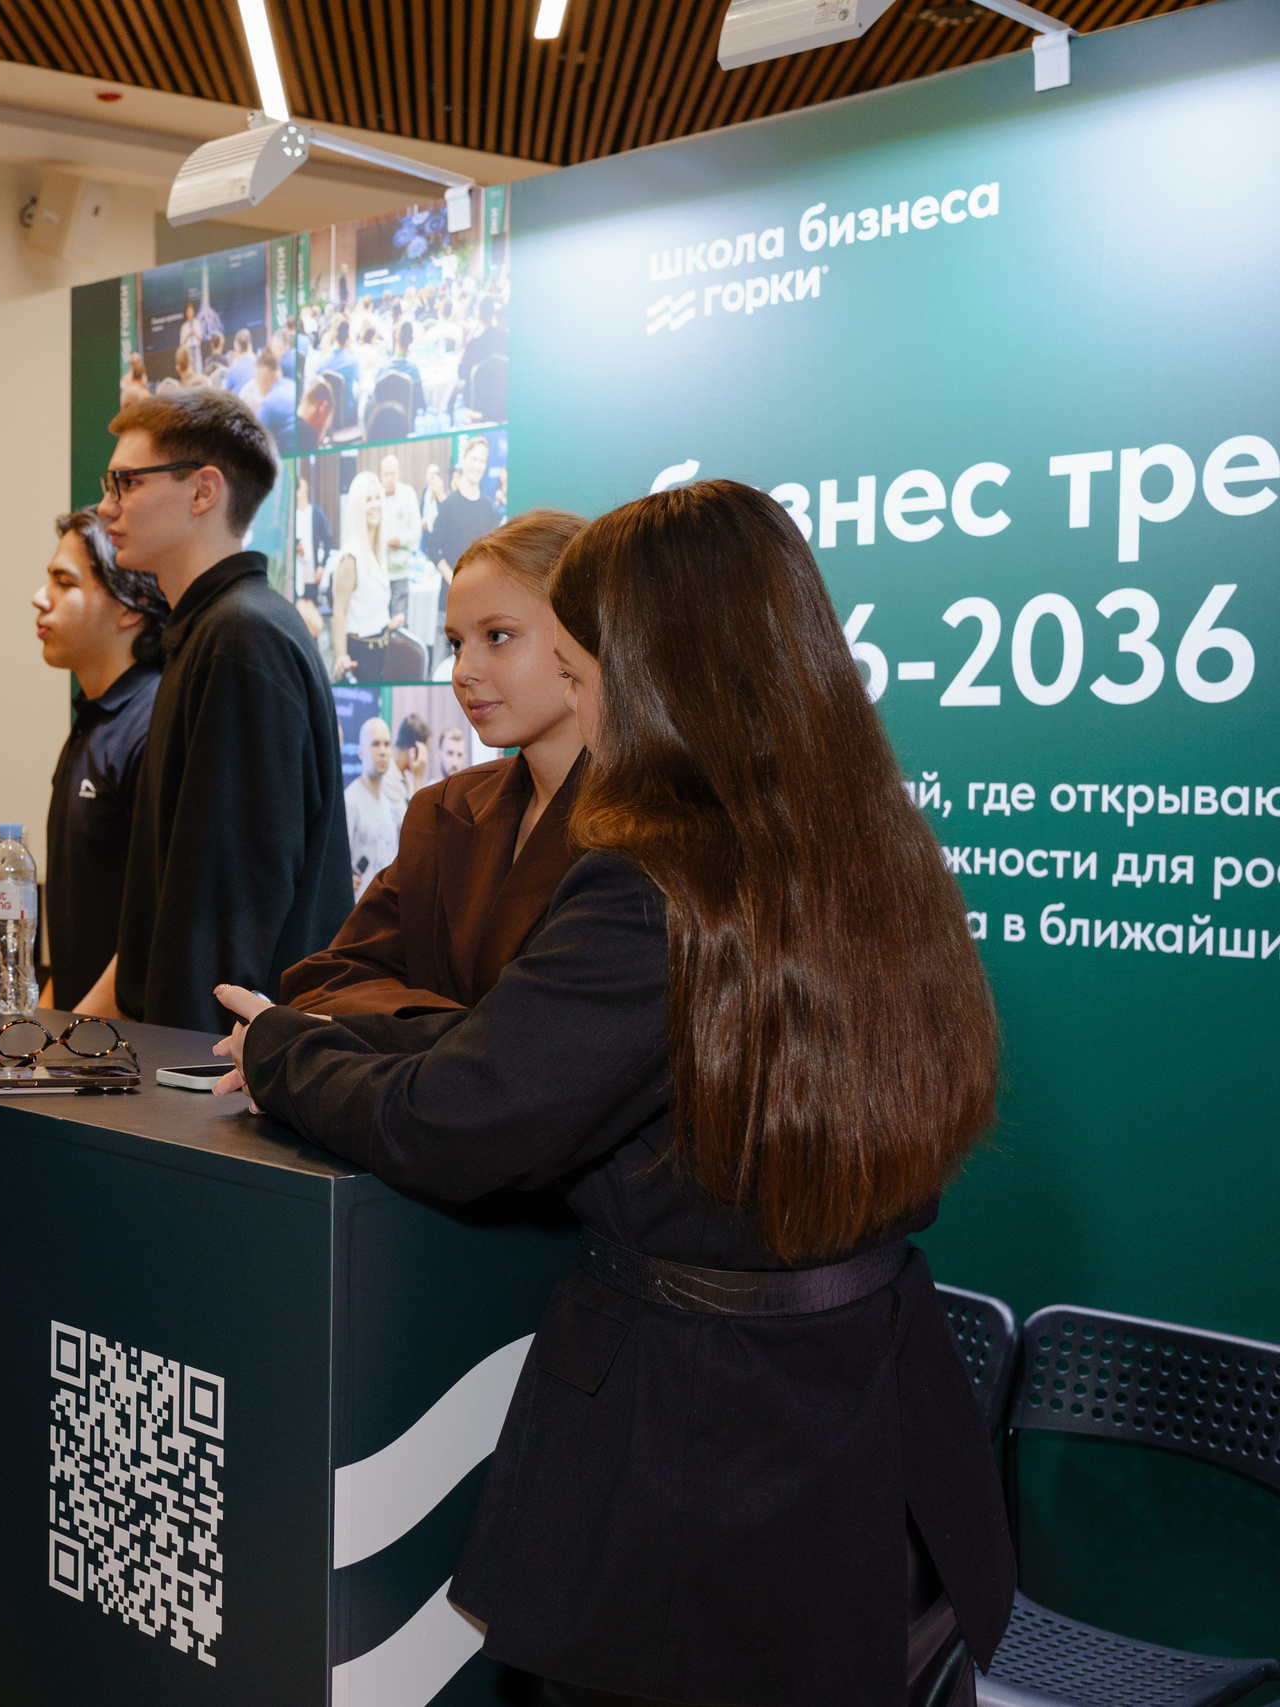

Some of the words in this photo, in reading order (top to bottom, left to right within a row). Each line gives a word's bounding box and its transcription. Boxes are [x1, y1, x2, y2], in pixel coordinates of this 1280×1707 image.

[650, 226, 784, 282] школа
[798, 181, 1000, 252] бизнеса
[703, 265, 821, 315] горки
[649, 458, 1012, 549] знес
[1049, 434, 1280, 563] тре
[968, 782, 1036, 817] где
[1112, 853, 1194, 888] для
[1213, 856, 1280, 900] ро
[1004, 913, 1026, 942] в
